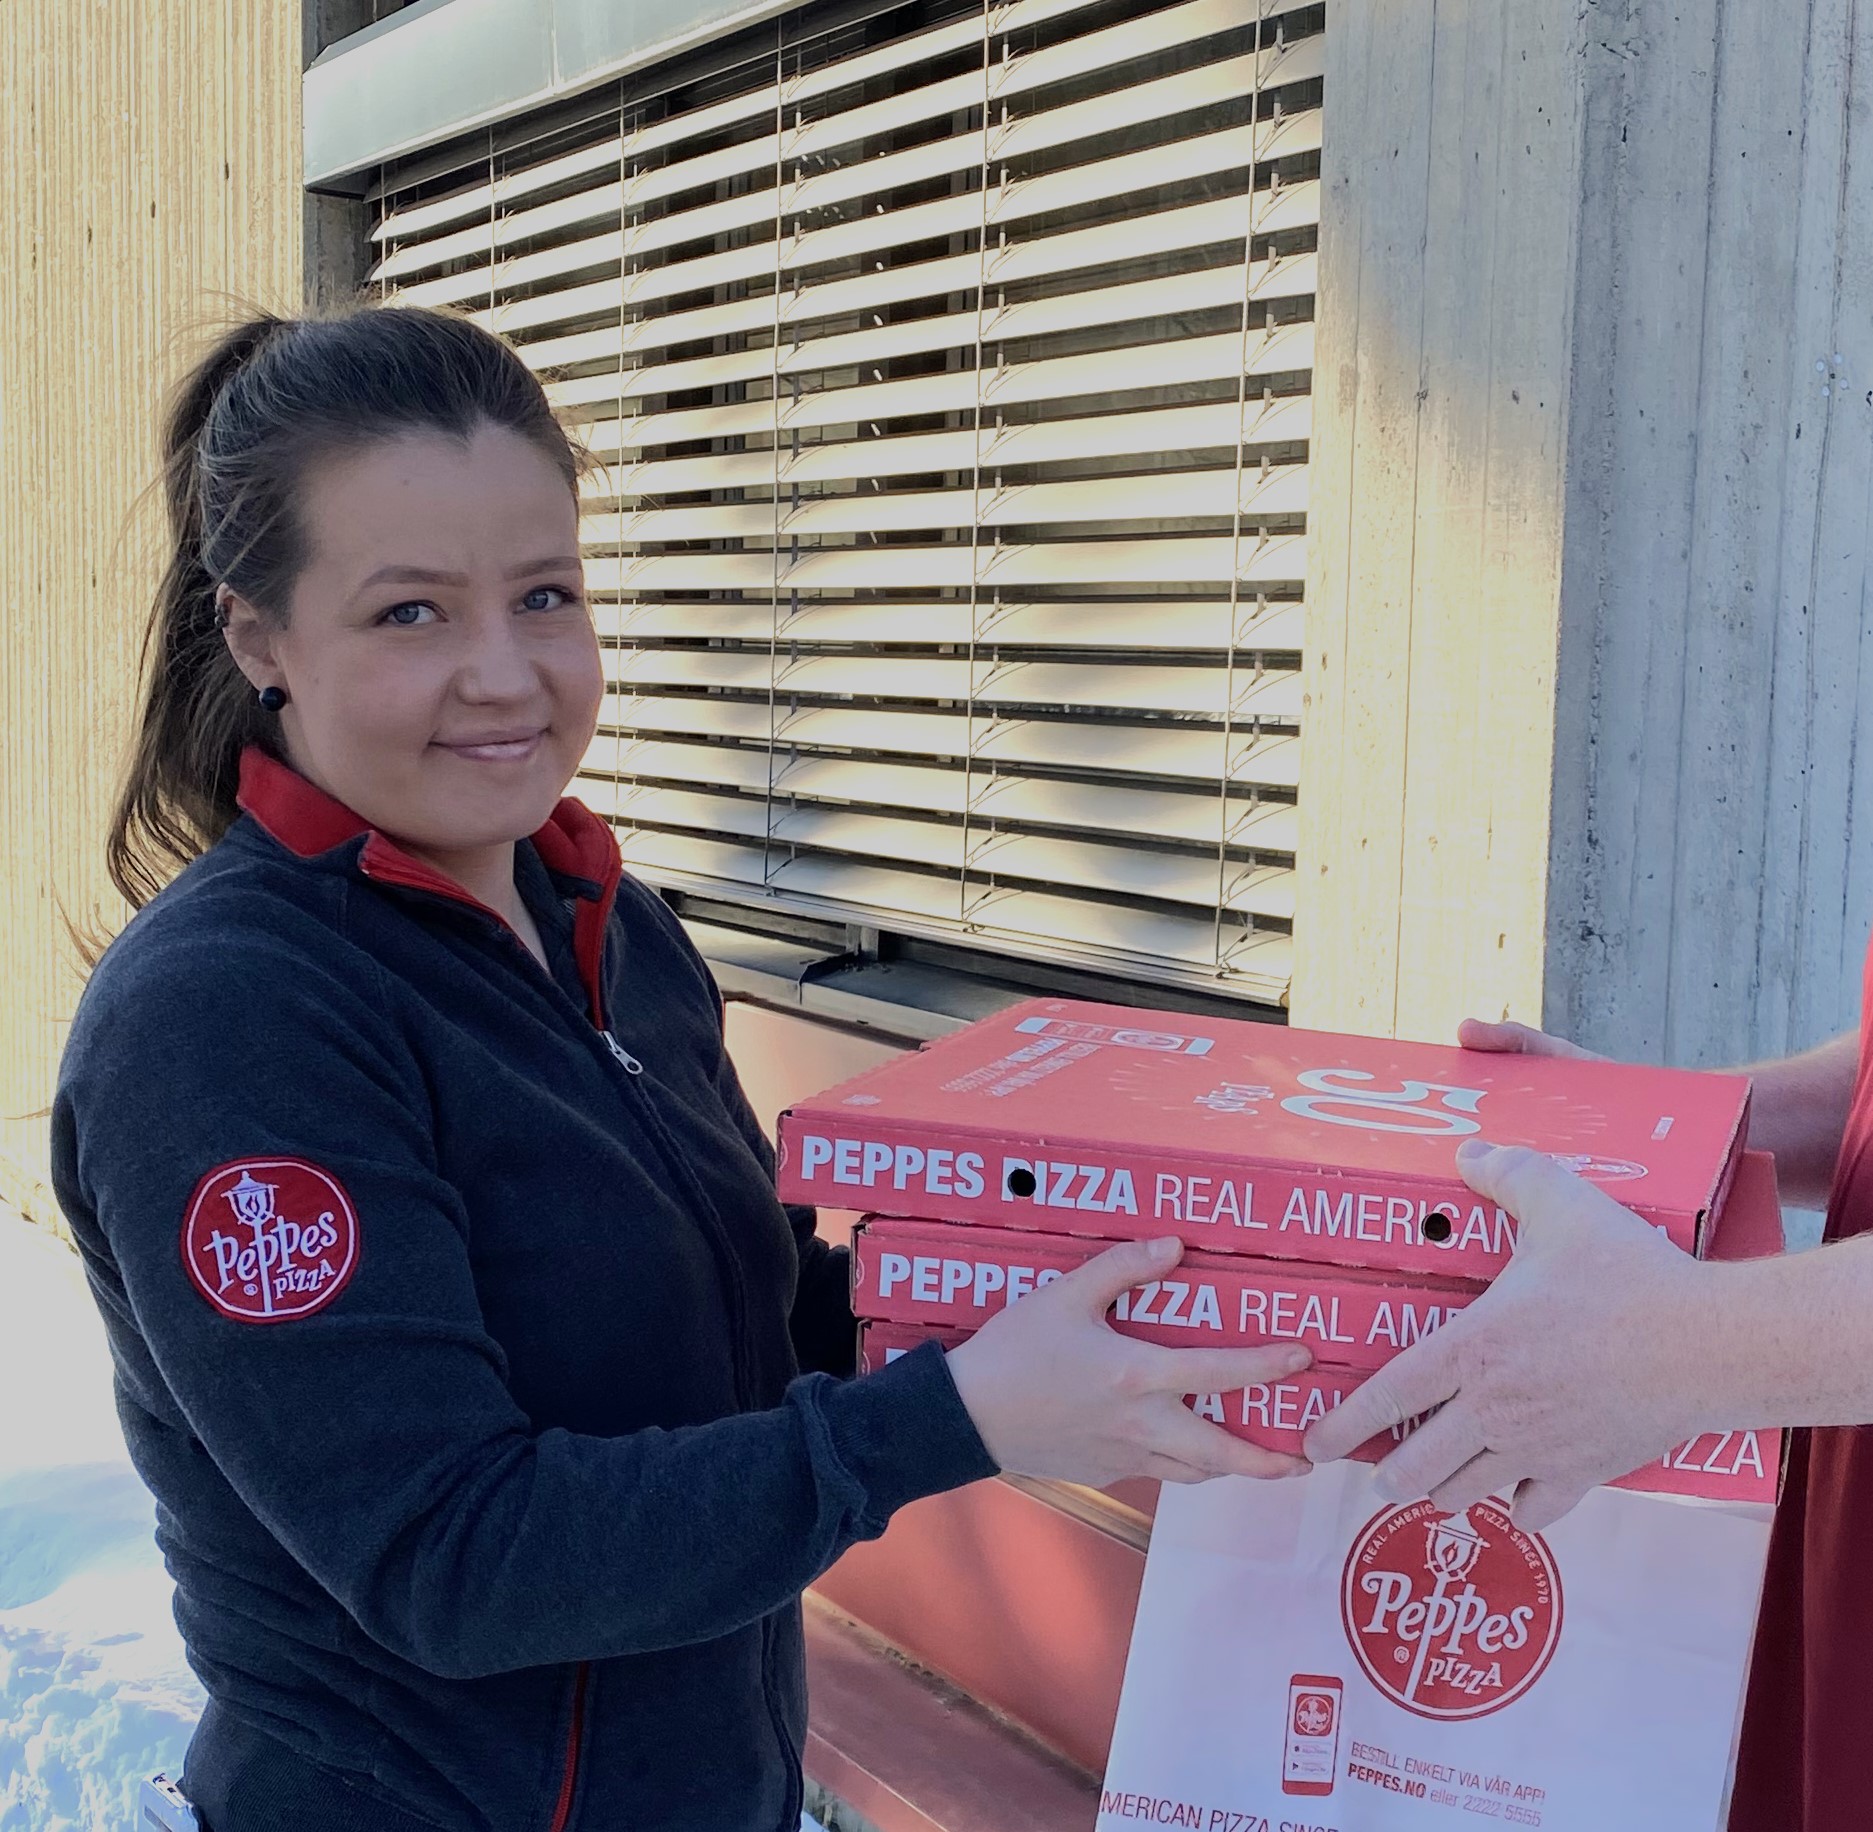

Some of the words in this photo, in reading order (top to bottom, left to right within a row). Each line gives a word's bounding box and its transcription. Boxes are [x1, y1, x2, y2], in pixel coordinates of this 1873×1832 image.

[801, 1135, 986, 1199] PEPPES
[1154, 1173, 1269, 1230] REAL
[1278, 1186, 1521, 1254] AMERICAN
[1116, 1280, 1223, 1331] IZZA
[1239, 1289, 1355, 1343] REAL
[1362, 1535, 1388, 1564] REAL
[1387, 1503, 1436, 1534] AMERIC
[1475, 1507, 1510, 1534] PIZZA
[1509, 1531, 1541, 1570] SINCE
[1533, 1572, 1549, 1605] 1970
[1361, 1571, 1534, 1655] Peppes
[1424, 1657, 1503, 1695] PIZZA
[1347, 1762, 1427, 1799] PEPPES.NO
[1430, 1788, 1459, 1808] eller
[1351, 1741, 1400, 1770] BESTILL
[1404, 1757, 1455, 1783] ENKELT
[1458, 1771, 1480, 1789] VIA
[1484, 1774, 1511, 1796] VÅR
[1101, 1790, 1203, 1830] MERICAN
